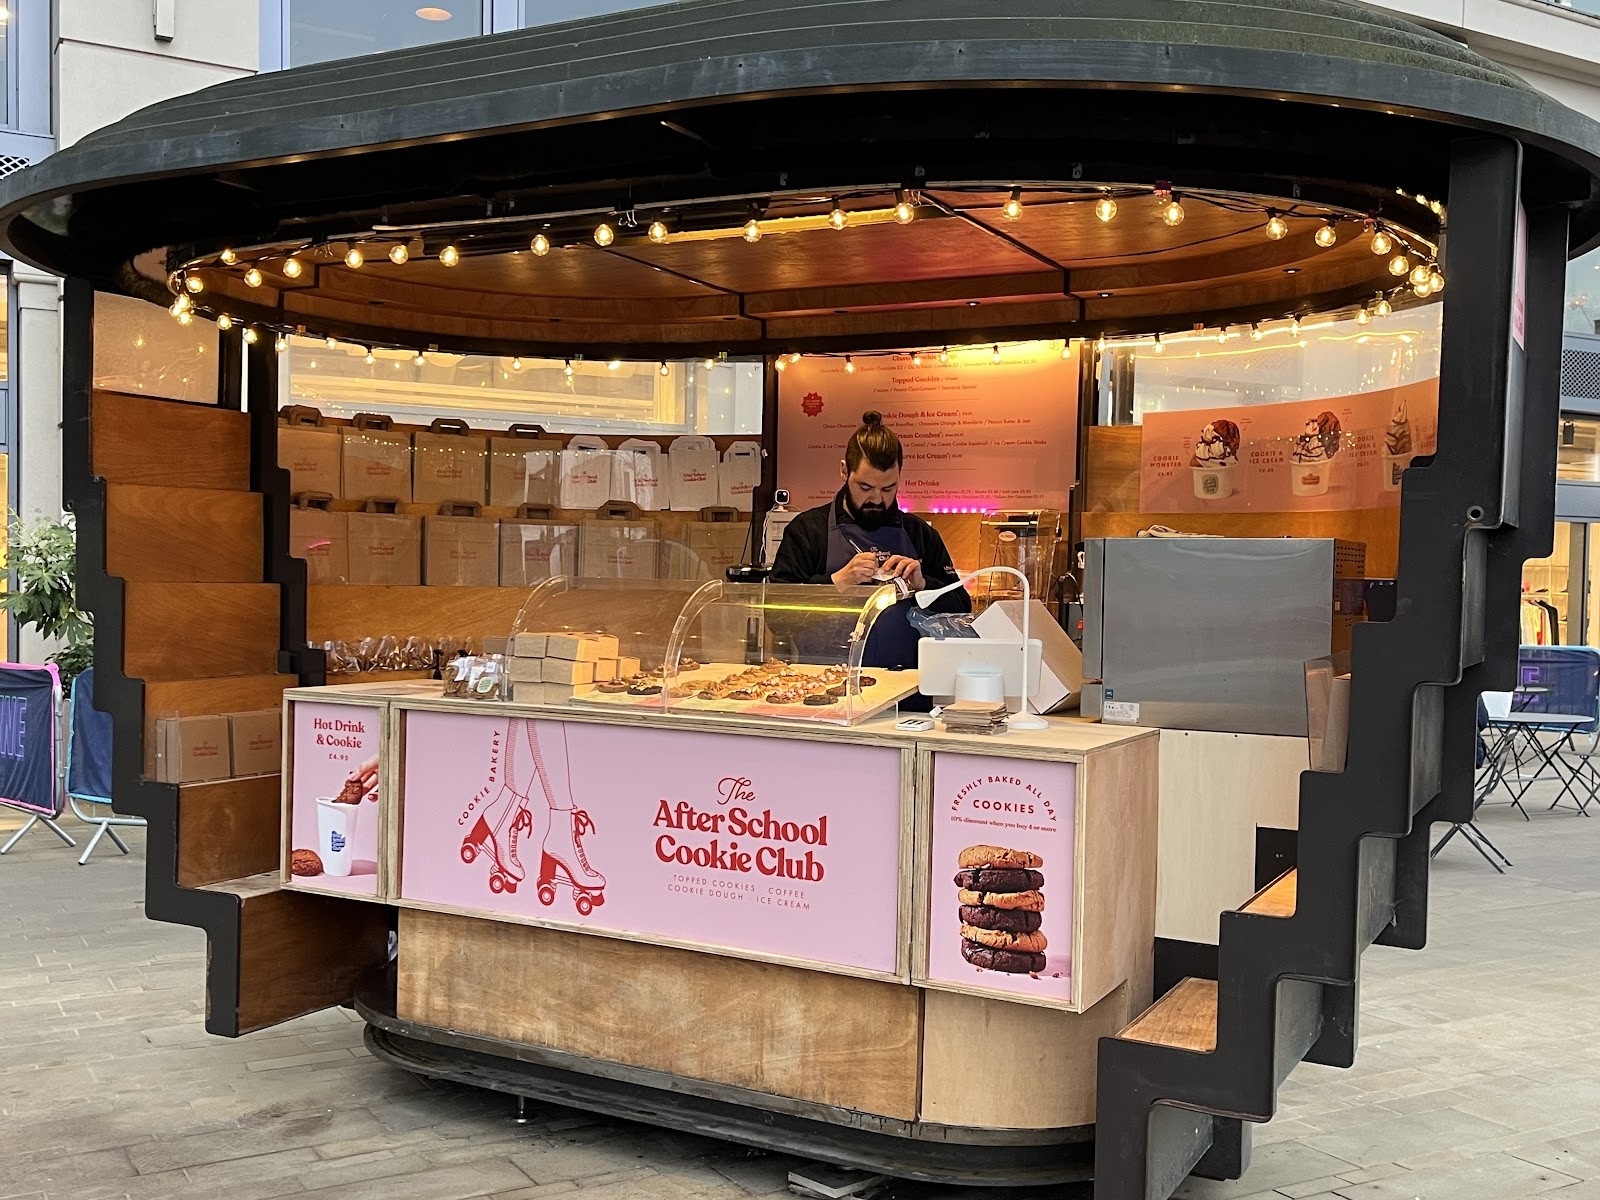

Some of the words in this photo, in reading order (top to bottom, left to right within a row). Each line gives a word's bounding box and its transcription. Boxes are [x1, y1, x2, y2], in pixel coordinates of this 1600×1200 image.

[314, 718, 333, 730] Hot
[335, 720, 366, 733] Drink
[316, 734, 324, 746] &
[326, 734, 362, 748] Cookie
[458, 786, 490, 826] COOKIE
[488, 730, 501, 783] BAKERY
[716, 777, 756, 805] The
[952, 778, 982, 812] FRESHLY
[988, 776, 1022, 786] BAKED
[1026, 784, 1042, 798] ALL
[1043, 800, 1057, 822] DAY
[972, 800, 1034, 814] COOKIES
[653, 800, 726, 834] After
[728, 807, 828, 846] School
[964, 816, 988, 825] discount
[1016, 822, 1028, 830] buy
[656, 834, 752, 872] Cookie
[756, 846, 824, 882] Club
[668, 884, 704, 896] COOKIE
[709, 890, 744, 900] DOUGH
[756, 896, 772, 904] ICE
[777, 898, 810, 910] CREAM
[673, 874, 707, 886] TOPPED
[712, 880, 756, 892] COOKIES
[768, 887, 806, 899] COFFEE
